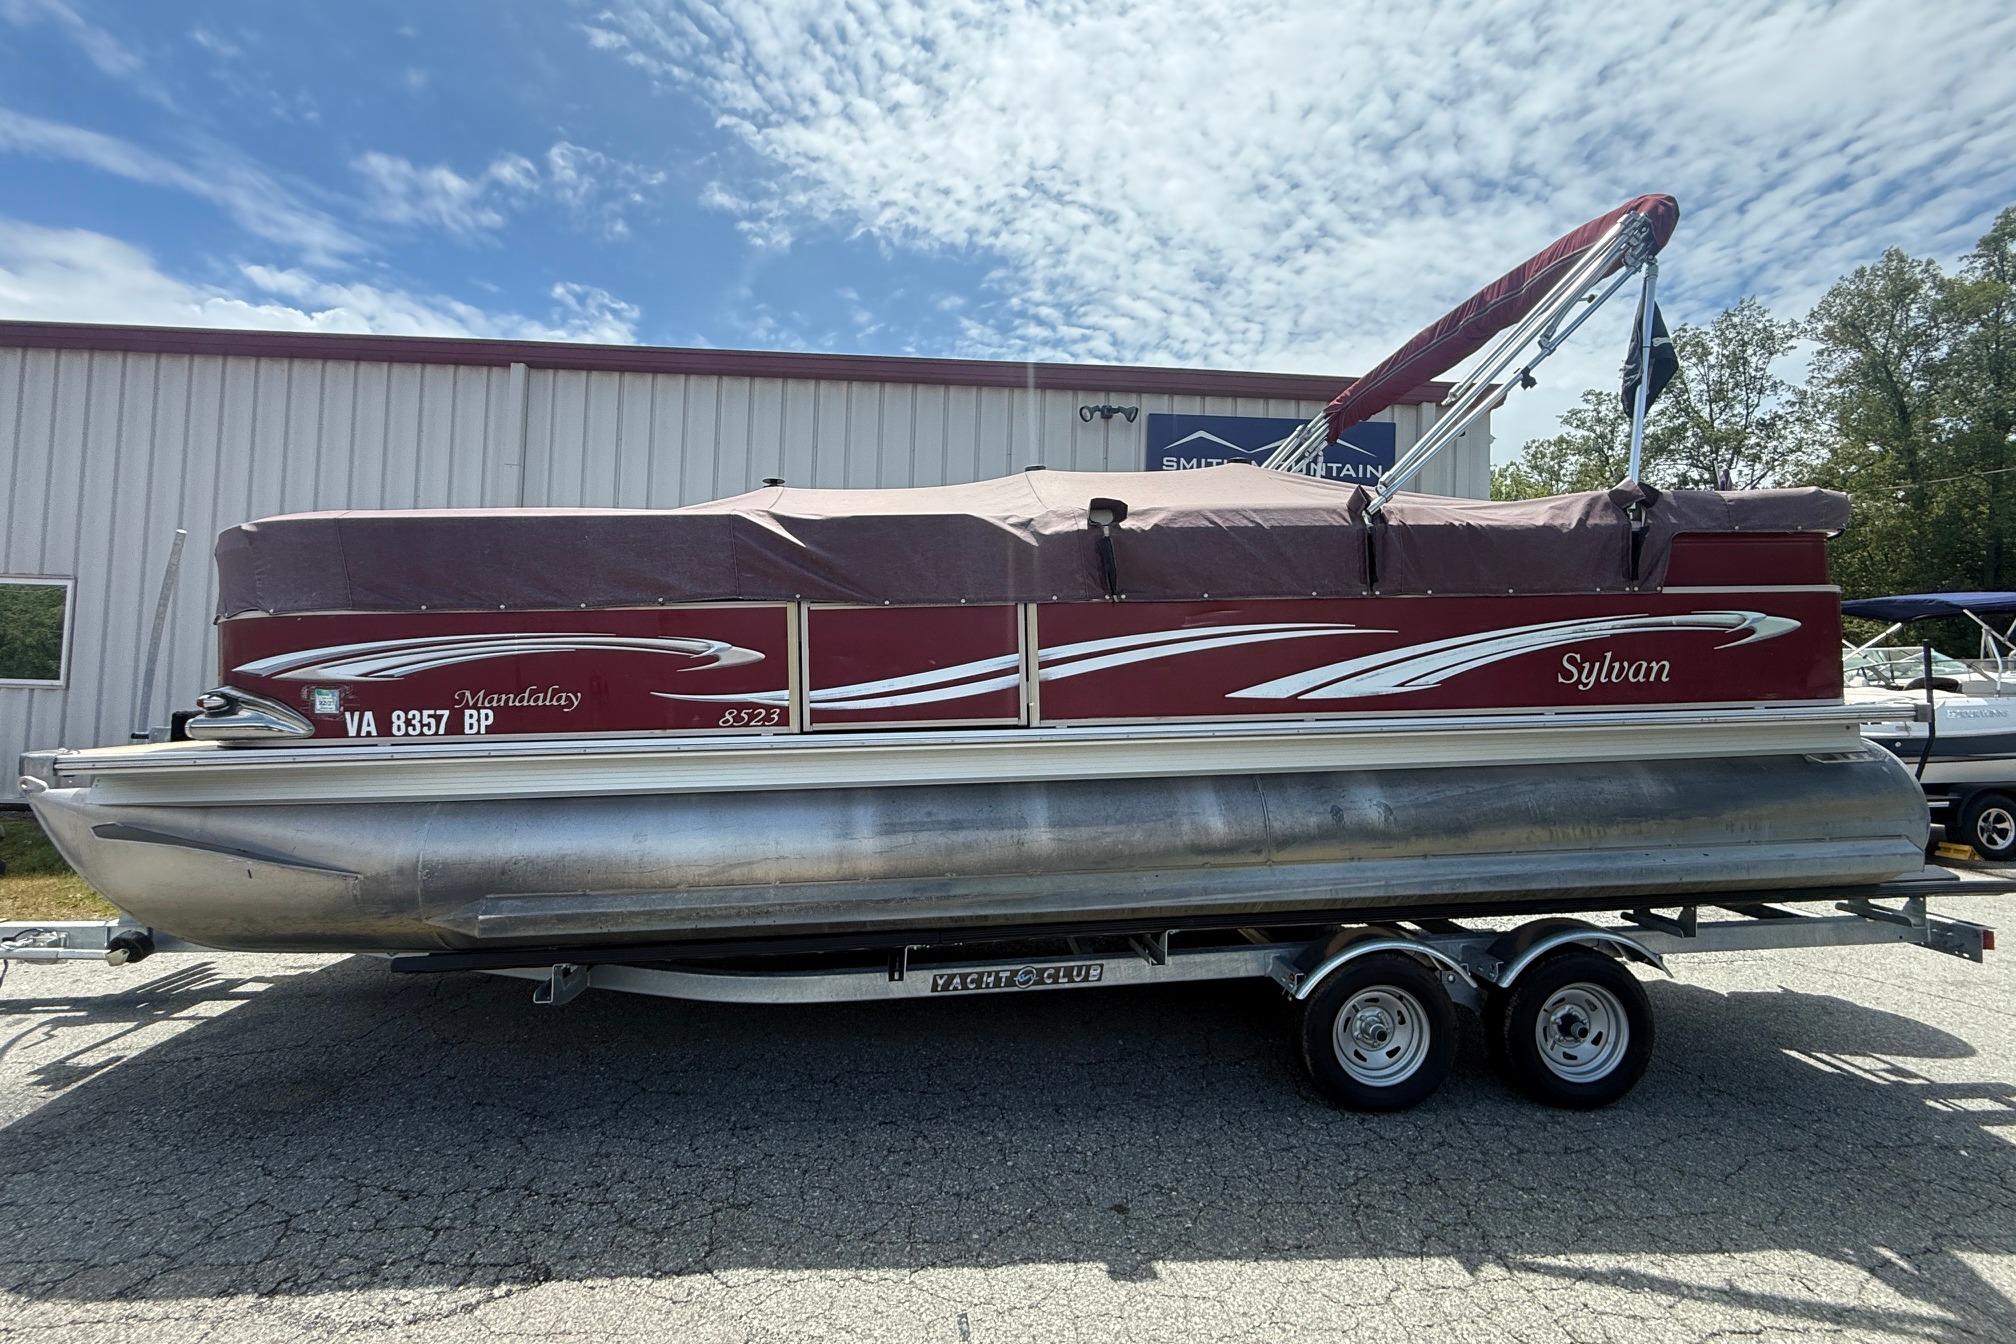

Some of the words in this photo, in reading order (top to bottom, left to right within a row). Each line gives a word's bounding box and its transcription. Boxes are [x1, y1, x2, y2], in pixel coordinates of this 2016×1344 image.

[1162, 457, 1229, 471] SMIT
[1557, 651, 1671, 691] Sylvan
[454, 685, 582, 712] Mandalay
[344, 710, 378, 737] VA
[391, 709, 450, 736] 8357
[464, 708, 494, 735] BP
[718, 708, 780, 727] 8523
[934, 971, 1011, 991] YACHT
[1042, 964, 1103, 984] CLUB
